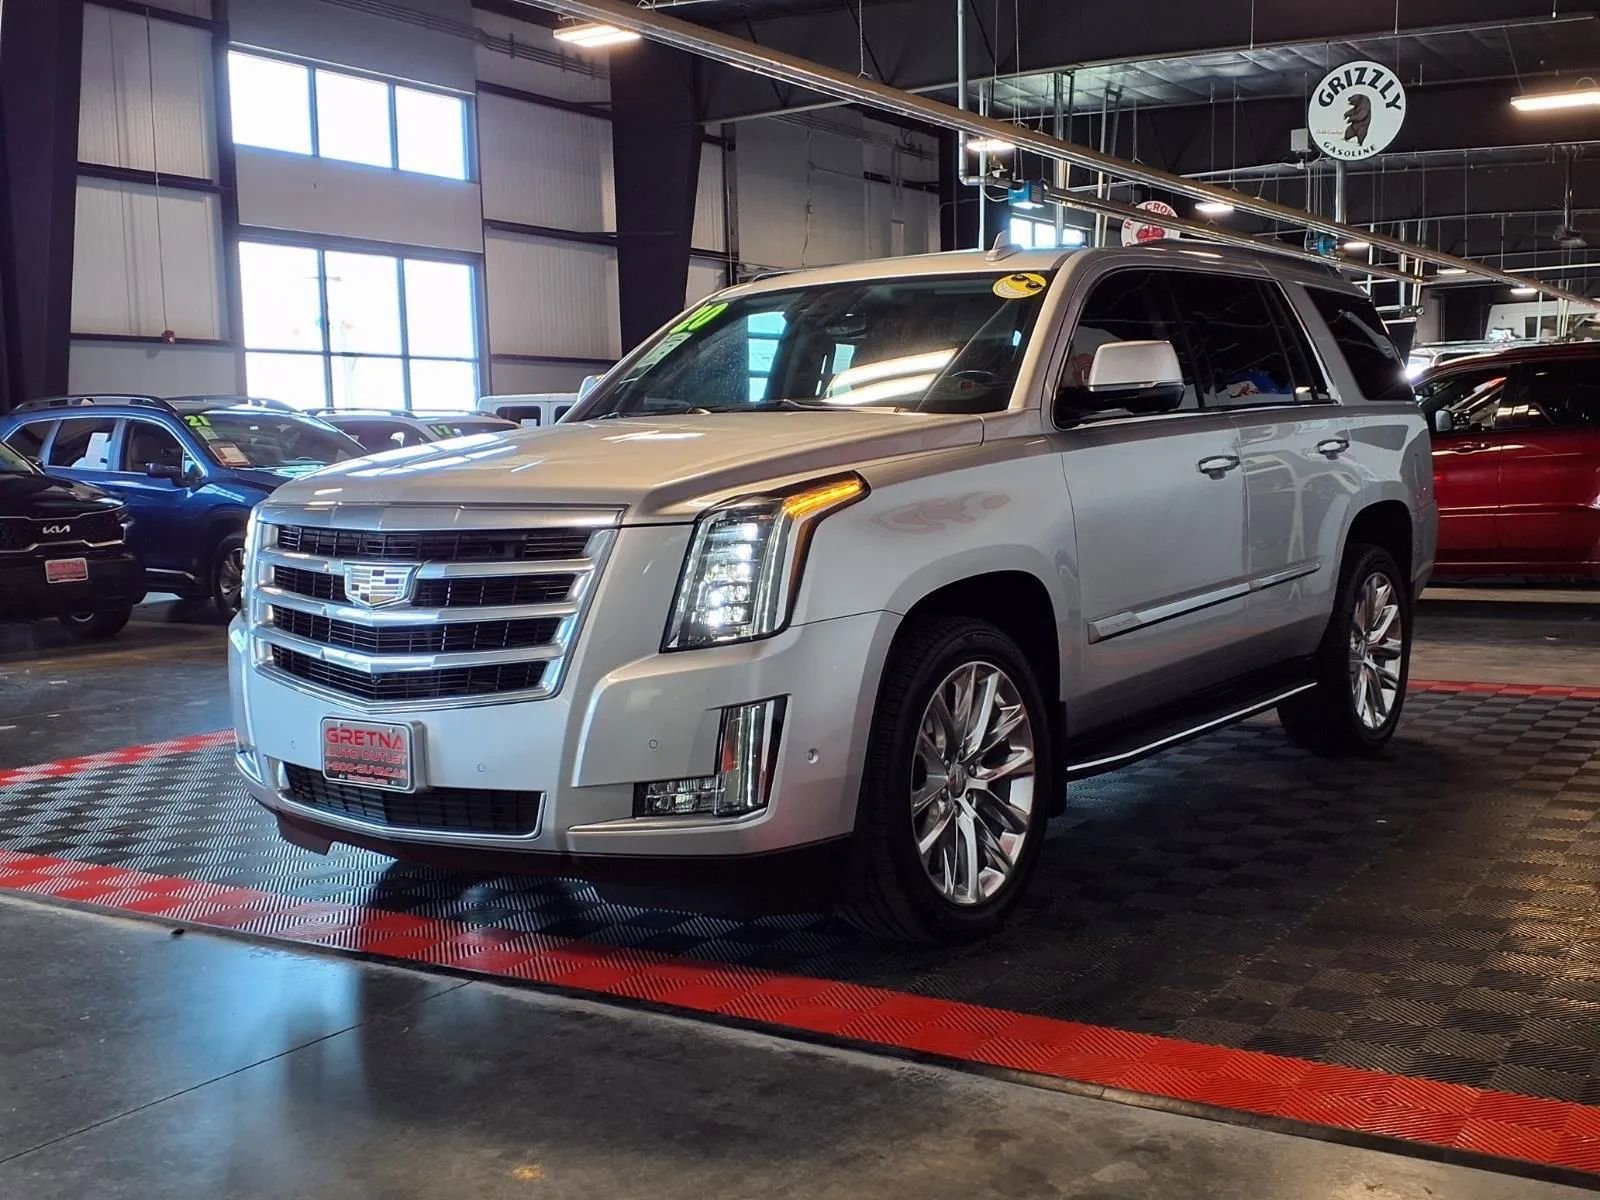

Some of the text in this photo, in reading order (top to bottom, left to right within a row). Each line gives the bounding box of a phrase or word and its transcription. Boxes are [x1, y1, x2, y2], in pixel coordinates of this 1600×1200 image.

[1318, 66, 1402, 111] GRIZZLY
[1323, 141, 1377, 157] GASOLINE
[184, 415, 212, 427] 21
[42, 524, 71, 534] KIA
[326, 727, 405, 751] GRETNA
[325, 747, 407, 765] AUTO OUTLET
